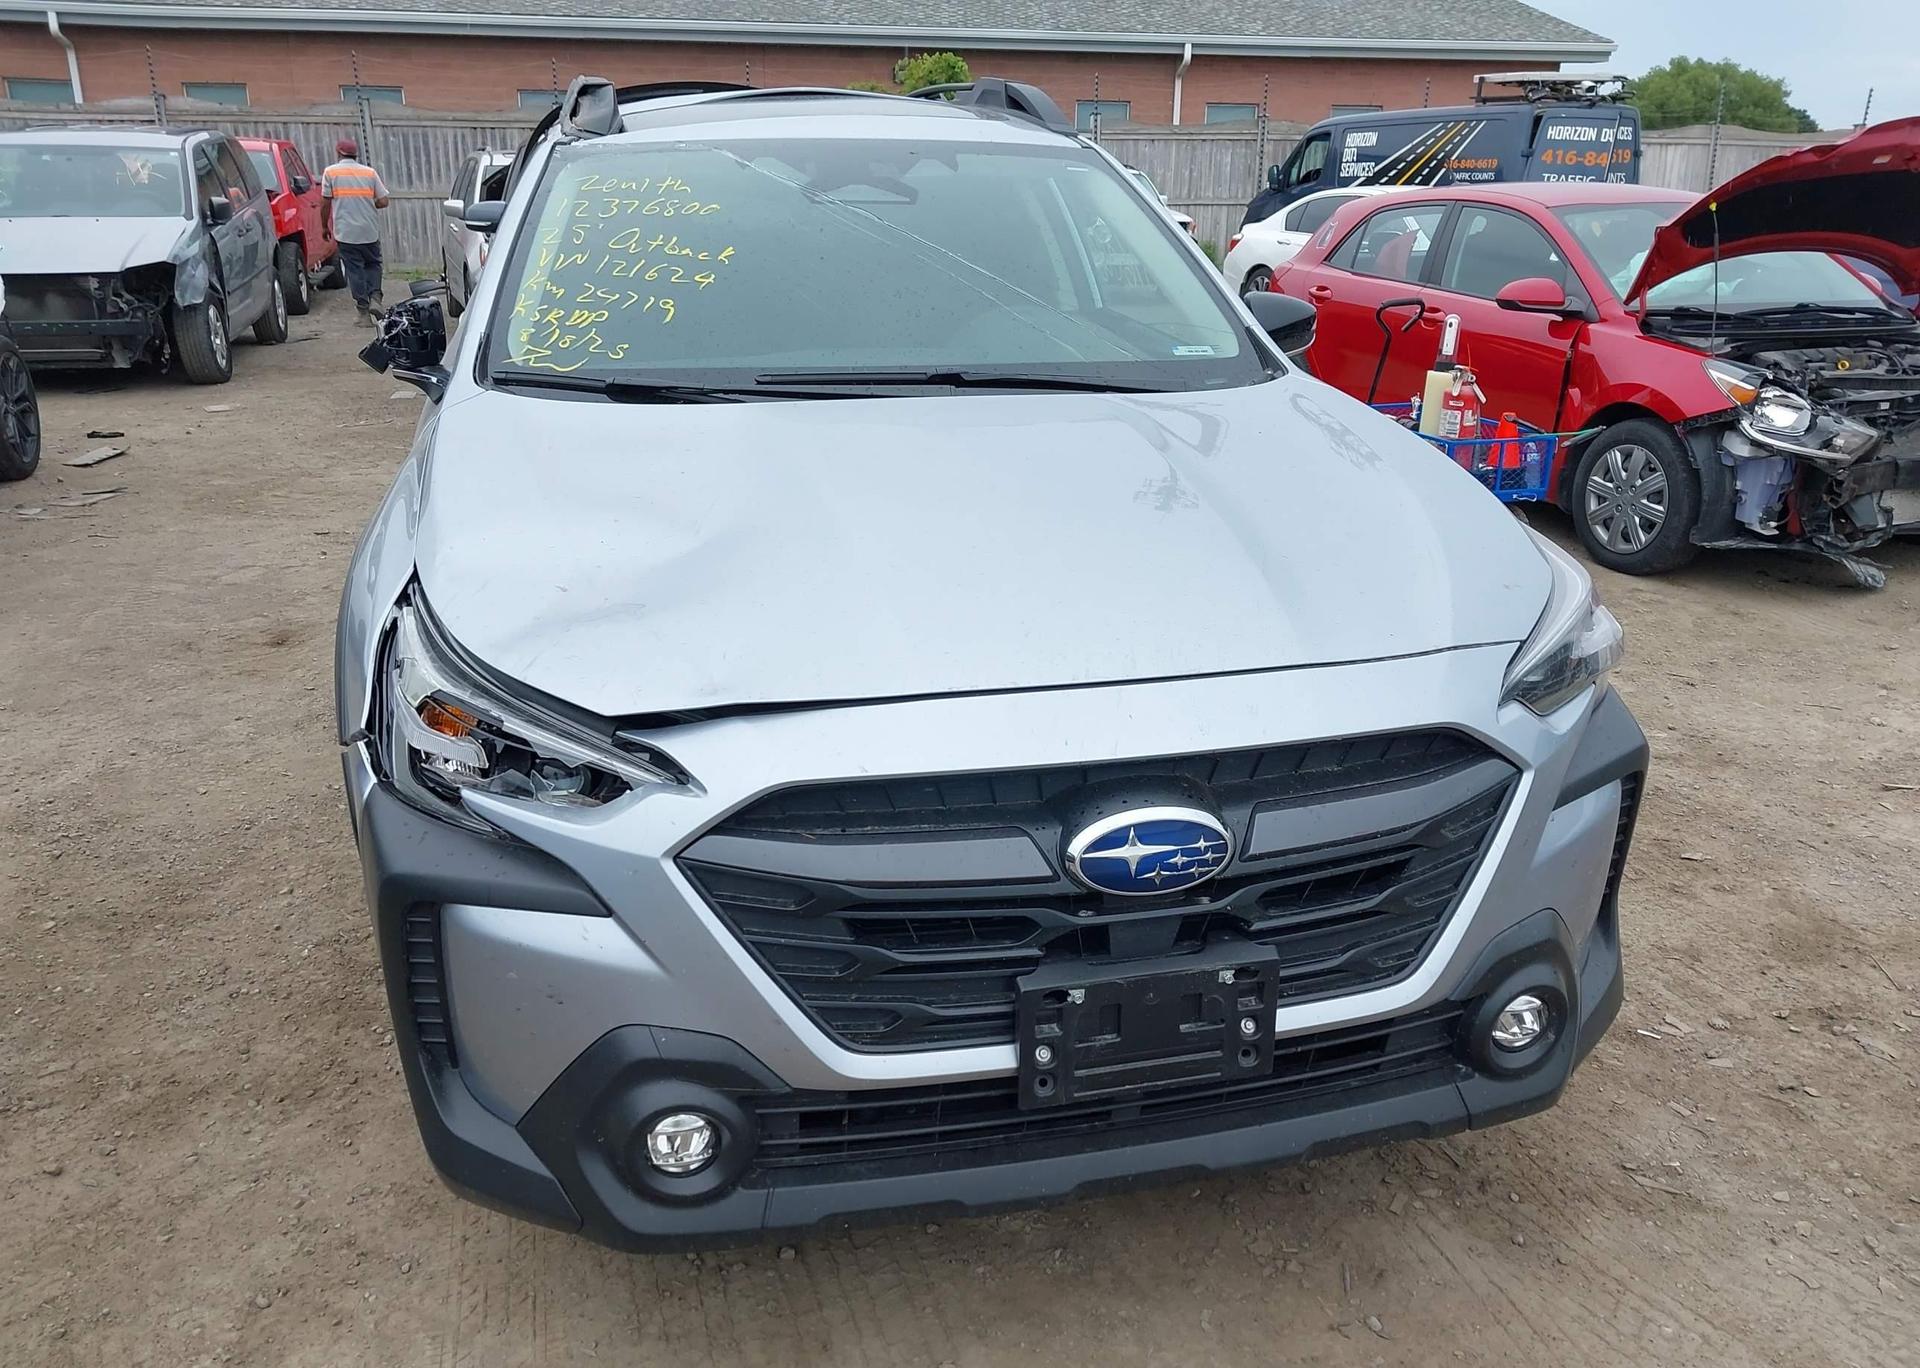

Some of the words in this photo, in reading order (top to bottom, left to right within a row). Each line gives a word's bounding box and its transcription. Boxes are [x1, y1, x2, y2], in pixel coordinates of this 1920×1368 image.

[1345, 131, 1379, 147] HORIZON
[1547, 125, 1597, 141] HORIZON
[1340, 162, 1376, 177] SERVICES
[1471, 172, 1496, 180] COUNTS
[556, 198, 721, 218] 12376800
[539, 248, 590, 272] VIN
